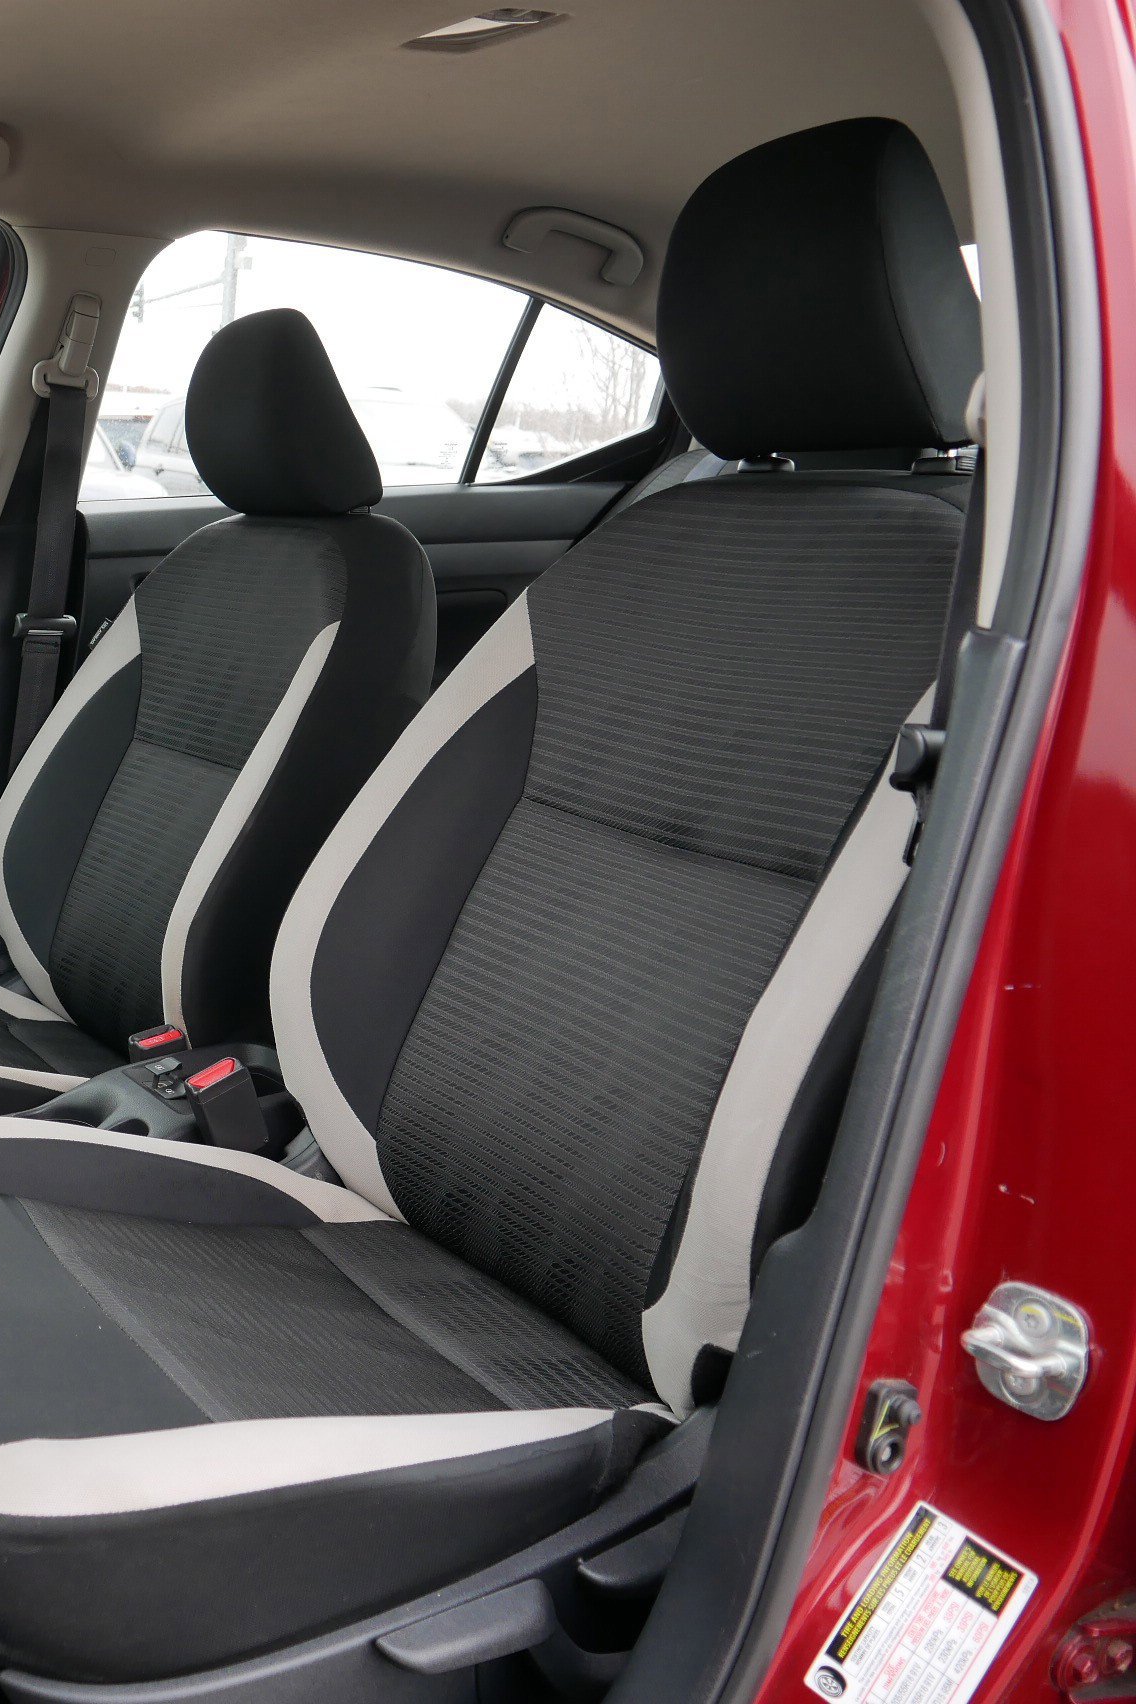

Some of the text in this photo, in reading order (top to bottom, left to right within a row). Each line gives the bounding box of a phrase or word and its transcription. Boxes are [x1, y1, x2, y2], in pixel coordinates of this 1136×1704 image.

[838, 1519, 932, 1659] RENSEIGNEMENTS SUR LES PNEUS ET LE CHARGEMENT
[841, 1531, 914, 1638] TIRE AND LOADING INFORMATION
